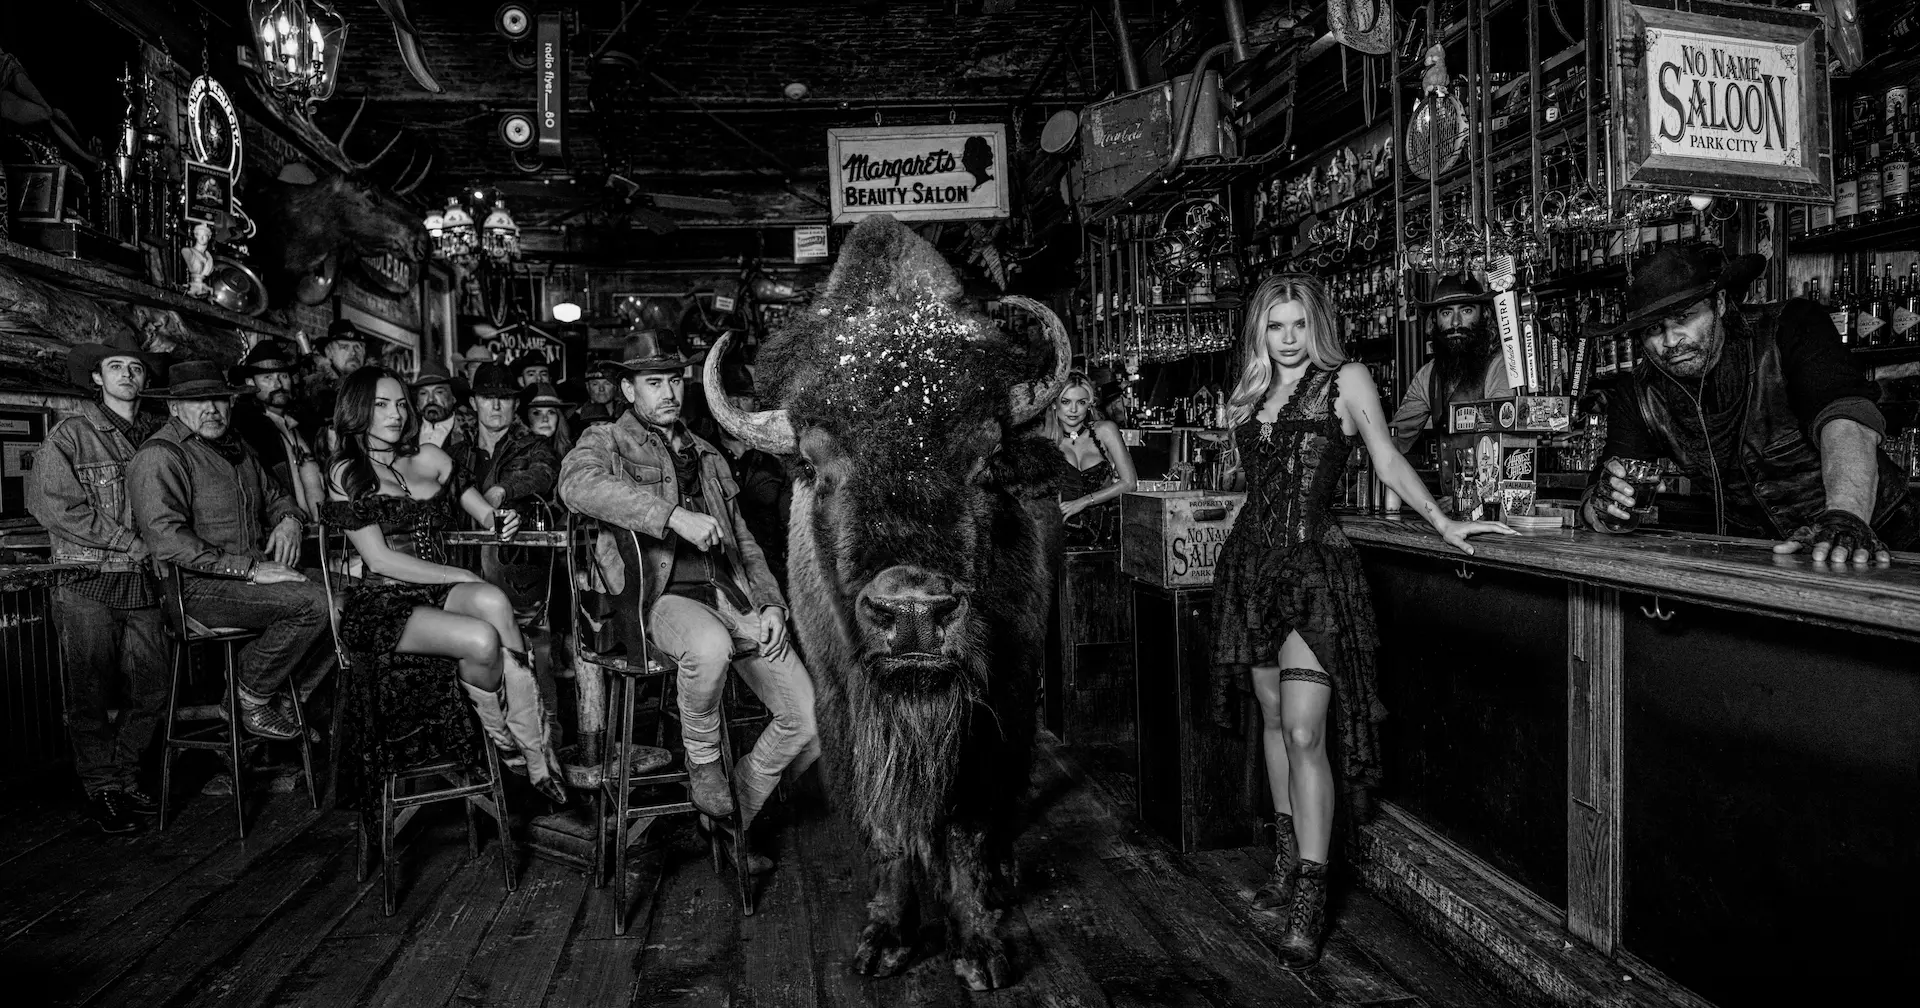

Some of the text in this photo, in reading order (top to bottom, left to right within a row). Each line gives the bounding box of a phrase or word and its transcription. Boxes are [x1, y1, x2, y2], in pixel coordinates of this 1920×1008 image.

[544, 42, 555, 69] radio
[1681, 44, 1763, 83] NO NAME
[1658, 61, 1788, 152] SALOON
[1690, 134, 1758, 153] PARK CITY
[845, 182, 968, 206] BEAUTY SALON
[1499, 298, 1511, 336] ULTRA
[501, 332, 516, 349] NO
[1526, 331, 1534, 361] UINTA
[1576, 337, 1587, 361] PROPER
[1572, 362, 1583, 390] BREWING
[1187, 527, 1230, 543] NO NAM
[1172, 537, 1223, 577] SALO
